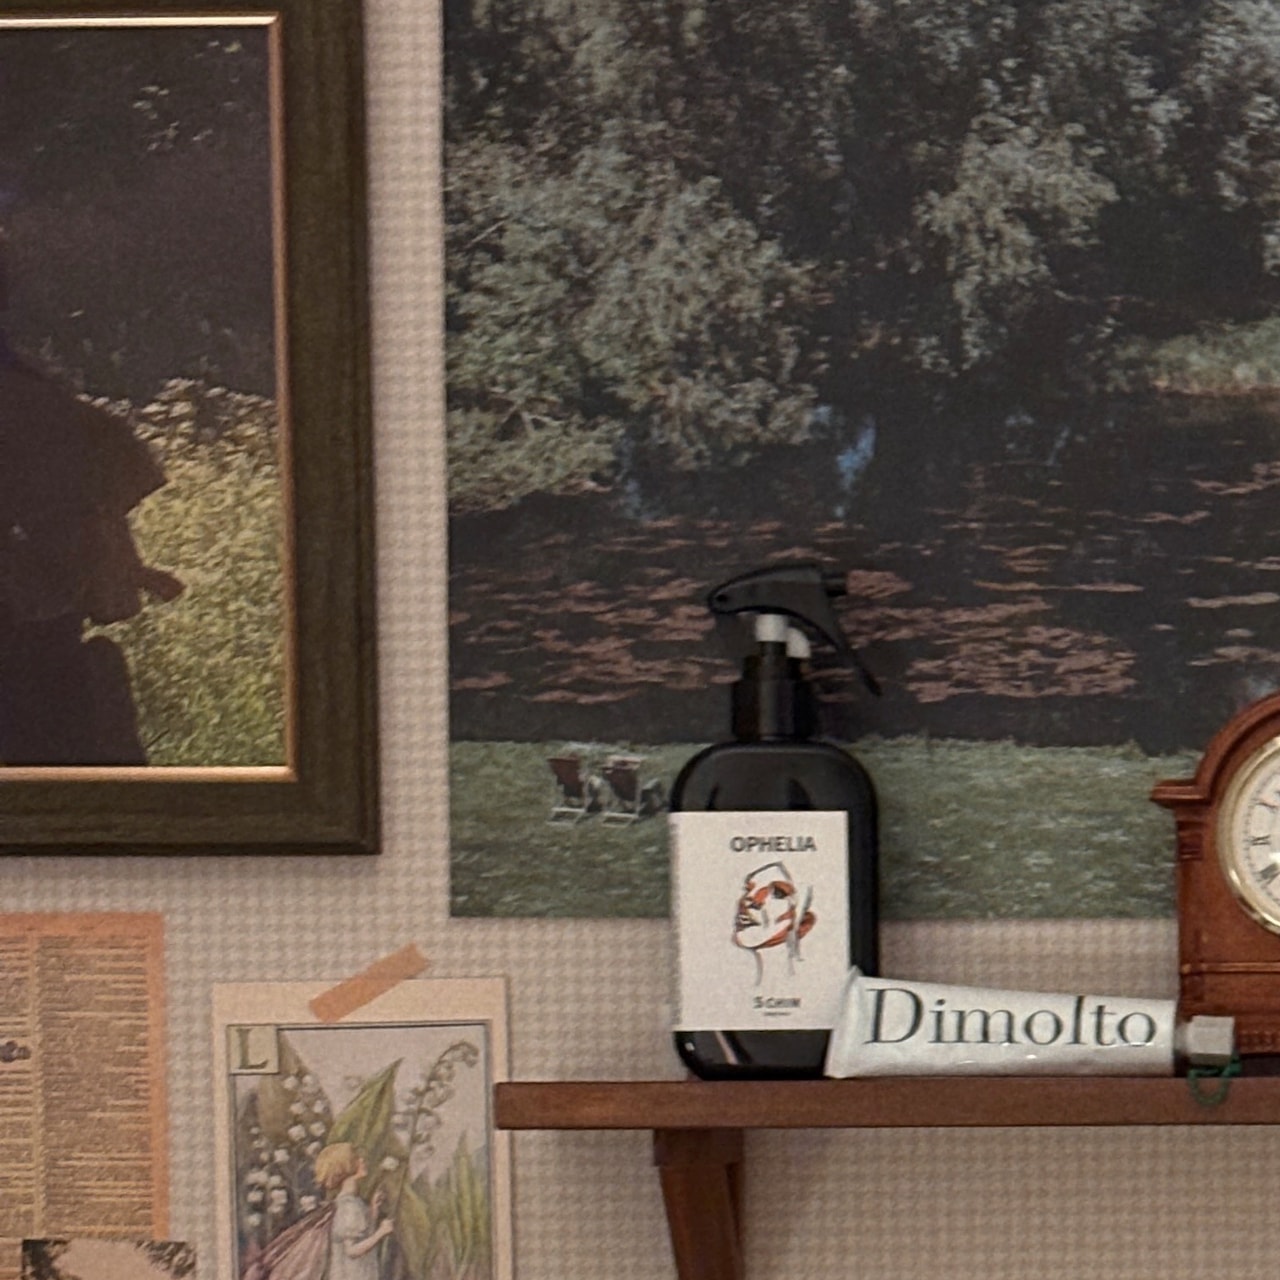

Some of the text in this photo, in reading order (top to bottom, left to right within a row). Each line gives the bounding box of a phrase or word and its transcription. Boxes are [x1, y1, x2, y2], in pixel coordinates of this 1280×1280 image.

[730, 835, 818, 853] OPHELIA
[863, 987, 1158, 1047] Dimolto
[239, 1028, 269, 1071] L
